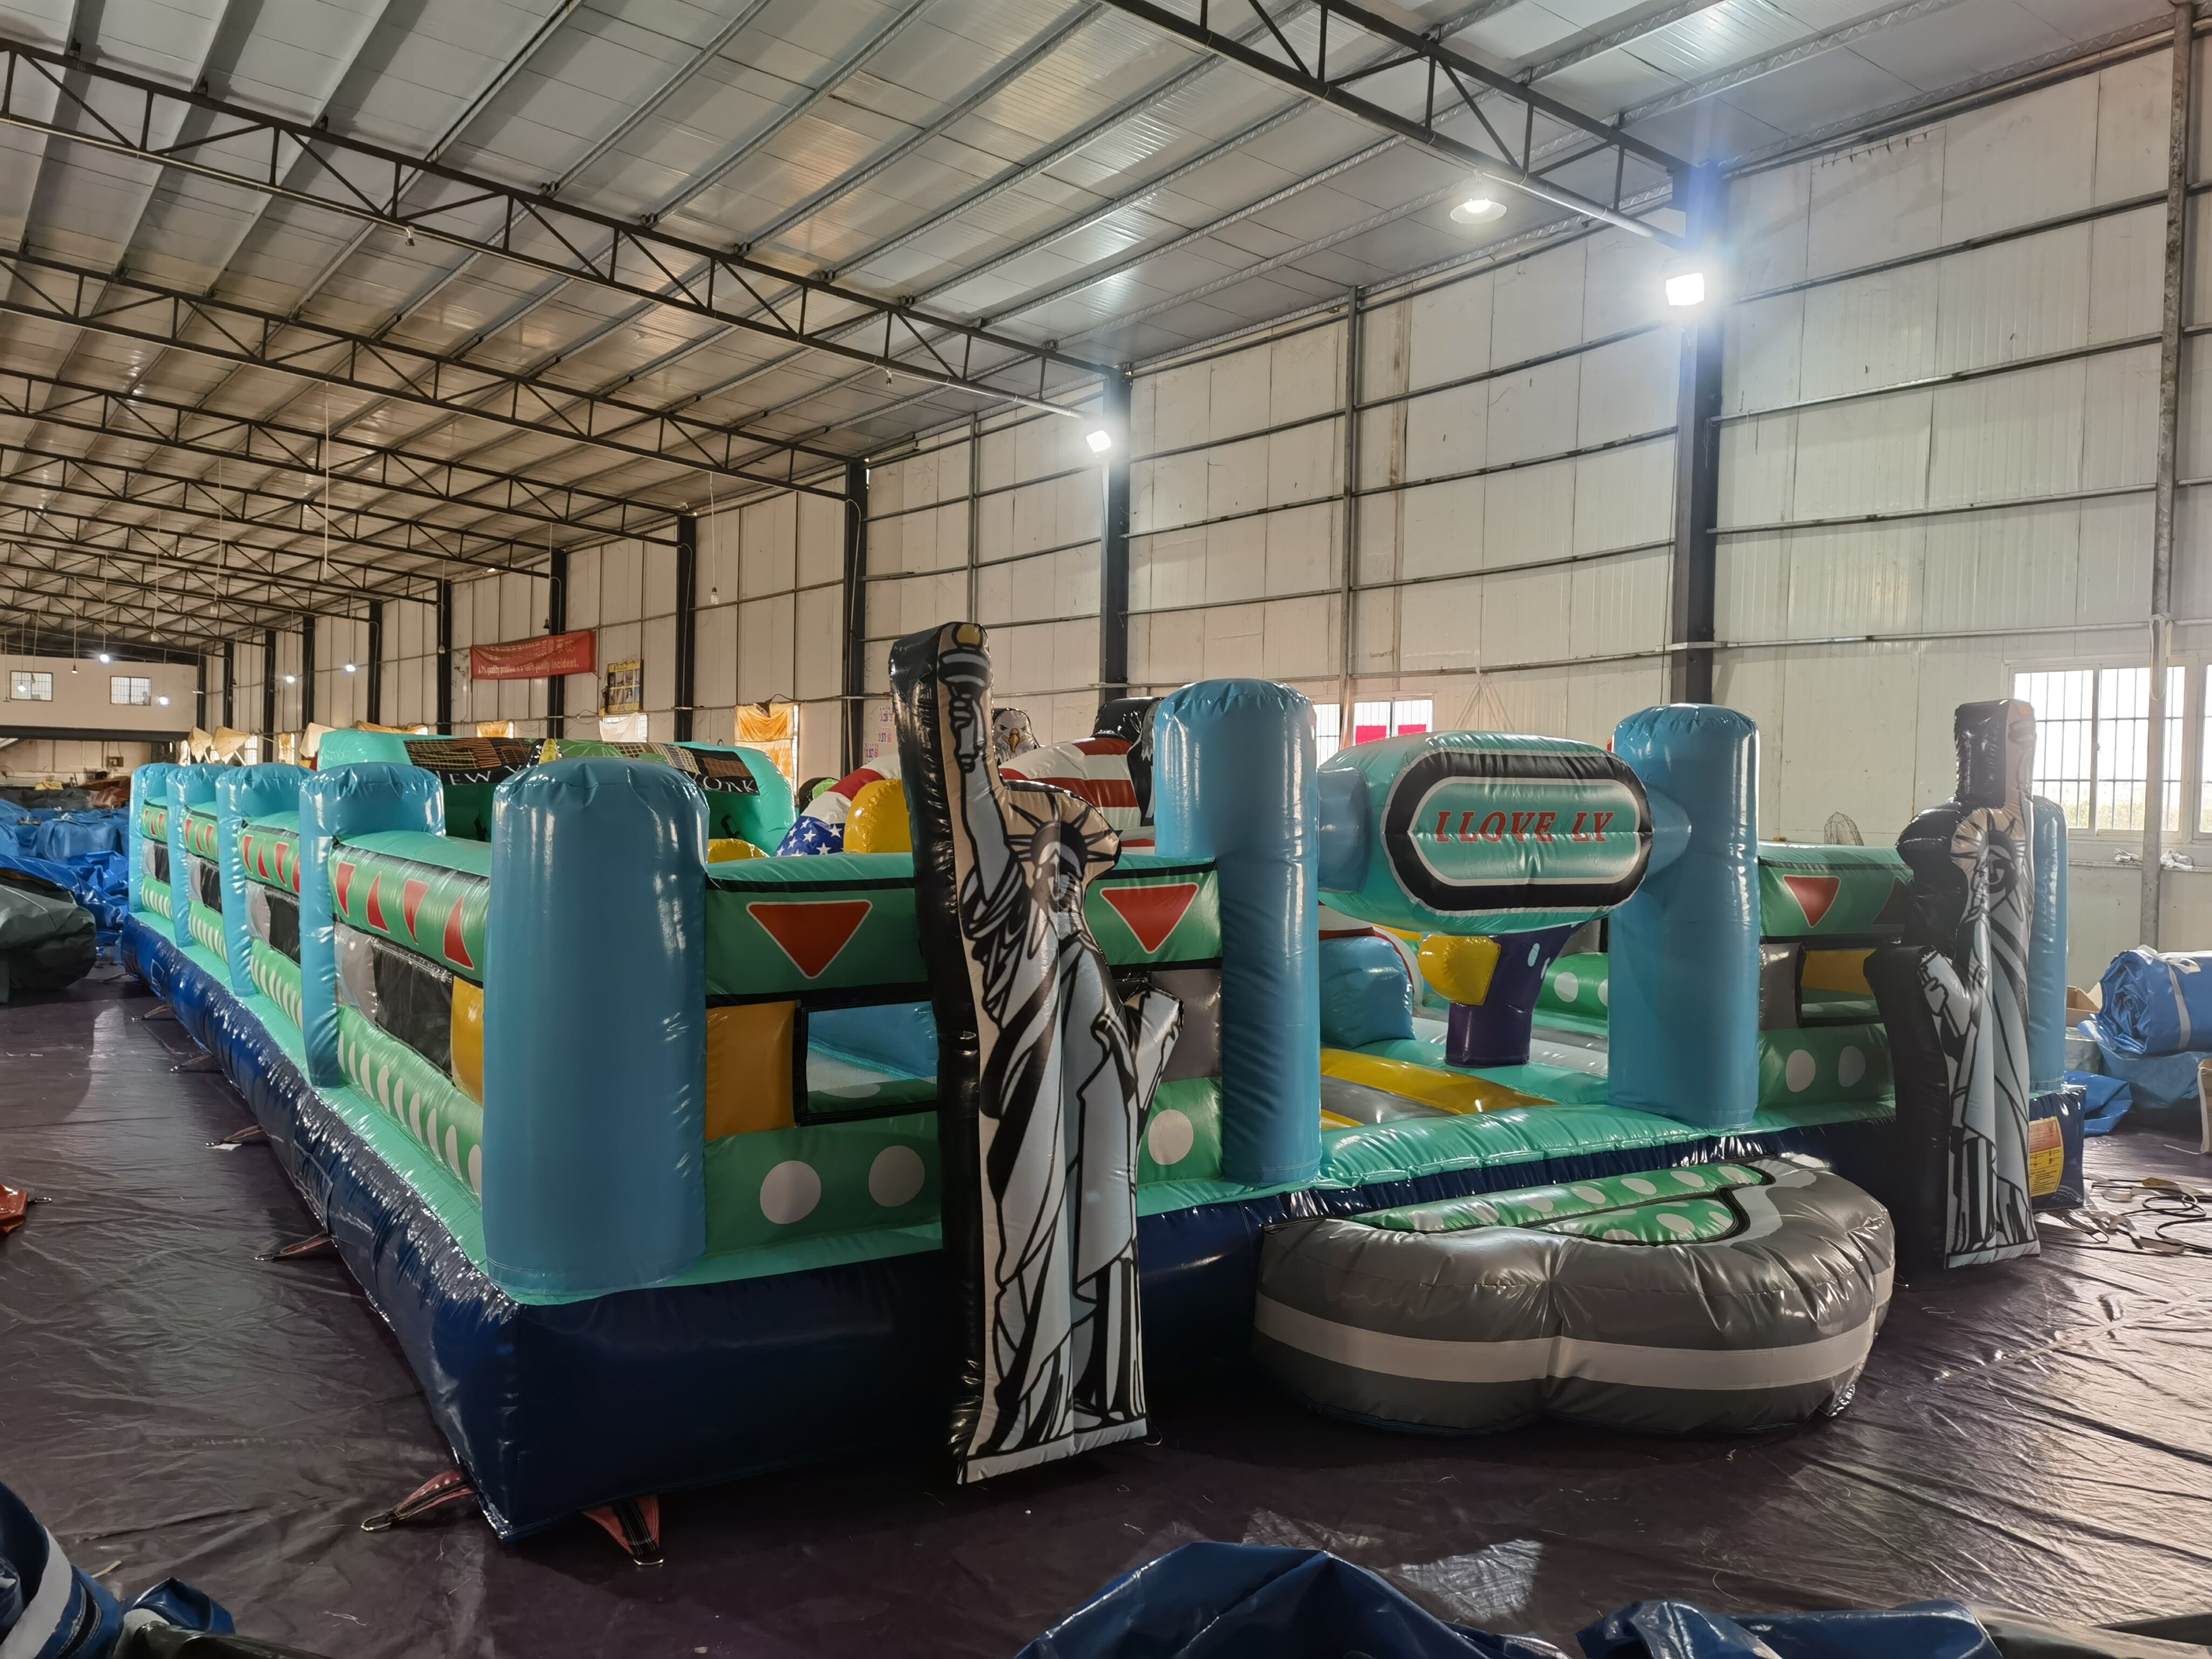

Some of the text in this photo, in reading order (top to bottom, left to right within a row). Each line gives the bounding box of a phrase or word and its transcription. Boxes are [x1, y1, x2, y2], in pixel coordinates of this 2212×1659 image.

[551, 657, 579, 670] incident.
[1435, 811, 1615, 843] I LOVE LY
